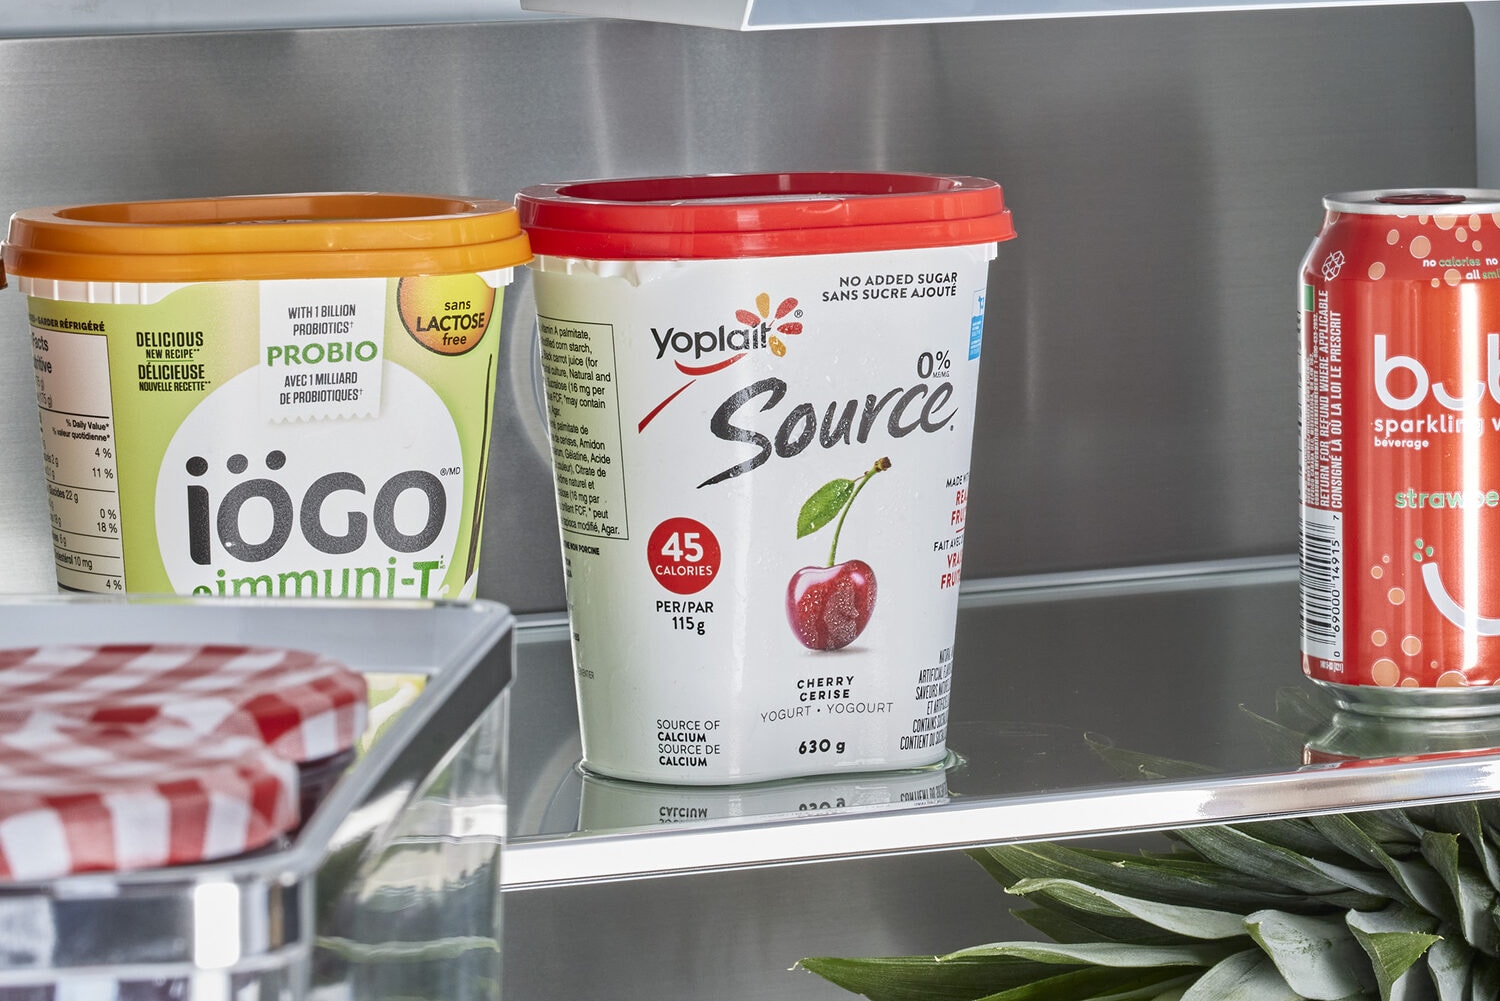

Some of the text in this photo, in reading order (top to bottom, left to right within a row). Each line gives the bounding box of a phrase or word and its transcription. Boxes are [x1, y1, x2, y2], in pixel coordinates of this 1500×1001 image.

[1423, 259, 1437, 267] no
[1485, 257, 1498, 266] no
[839, 272, 958, 288] NO ADDED SUGAR
[1465, 269, 1480, 280] all
[822, 283, 957, 302] SANS SUCRE AJOUTÉ
[288, 304, 356, 319] WITH 1 BILLION
[444, 300, 471, 311] sans
[60, 317, 105, 332] RÉFRIGÉRÉ
[416, 313, 485, 332] LACTOSE
[136, 331, 203, 347] DELICIOUS
[442, 333, 467, 346] free
[145, 350, 162, 359] NEW
[267, 340, 378, 367] PROBIO
[138, 361, 205, 380] DÉLICIEUSE
[569, 368, 611, 383] Natural and
[284, 372, 357, 388] AVEC 1 MILLIARD
[139, 382, 172, 392] NOUVELLE
[579, 386, 605, 397] mg per
[280, 393, 292, 405] DE
[579, 397, 606, 409] contain
[1317, 290, 1330, 507] RETURN FOR REFUND WHERE APPLICABLE
[1328, 310, 1342, 508] CONSIGNÉ LÀ OÙ LA LOI LE PRESCRIT
[696, 376, 959, 489] Source
[580, 439, 605, 450] Amidon
[1374, 437, 1429, 450] beverage
[590, 454, 611, 465] Acide
[92, 468, 101, 478] 11
[596, 467, 607, 477] de
[593, 509, 609, 519] peut
[97, 522, 106, 533] 18
[601, 523, 620, 536] Agar.
[661, 532, 704, 562] 45
[933, 540, 949, 552] FAIT
[655, 565, 713, 576] CALORIES
[1331, 540, 1340, 633] 69000 14915
[656, 600, 714, 613] PER/PAR
[672, 616, 706, 636] 115 g
[797, 676, 854, 689] CHERRY
[799, 689, 850, 701] CERISE
[761, 702, 893, 723] YOGURT YOGOURT
[657, 719, 720, 731] SOURCE OF
[657, 732, 706, 742] CALCIUM
[900, 733, 929, 750] CONTIENT
[658, 743, 720, 754] SOURCE DE
[798, 739, 846, 755] 630 g
[659, 756, 707, 766] CALCIUM
